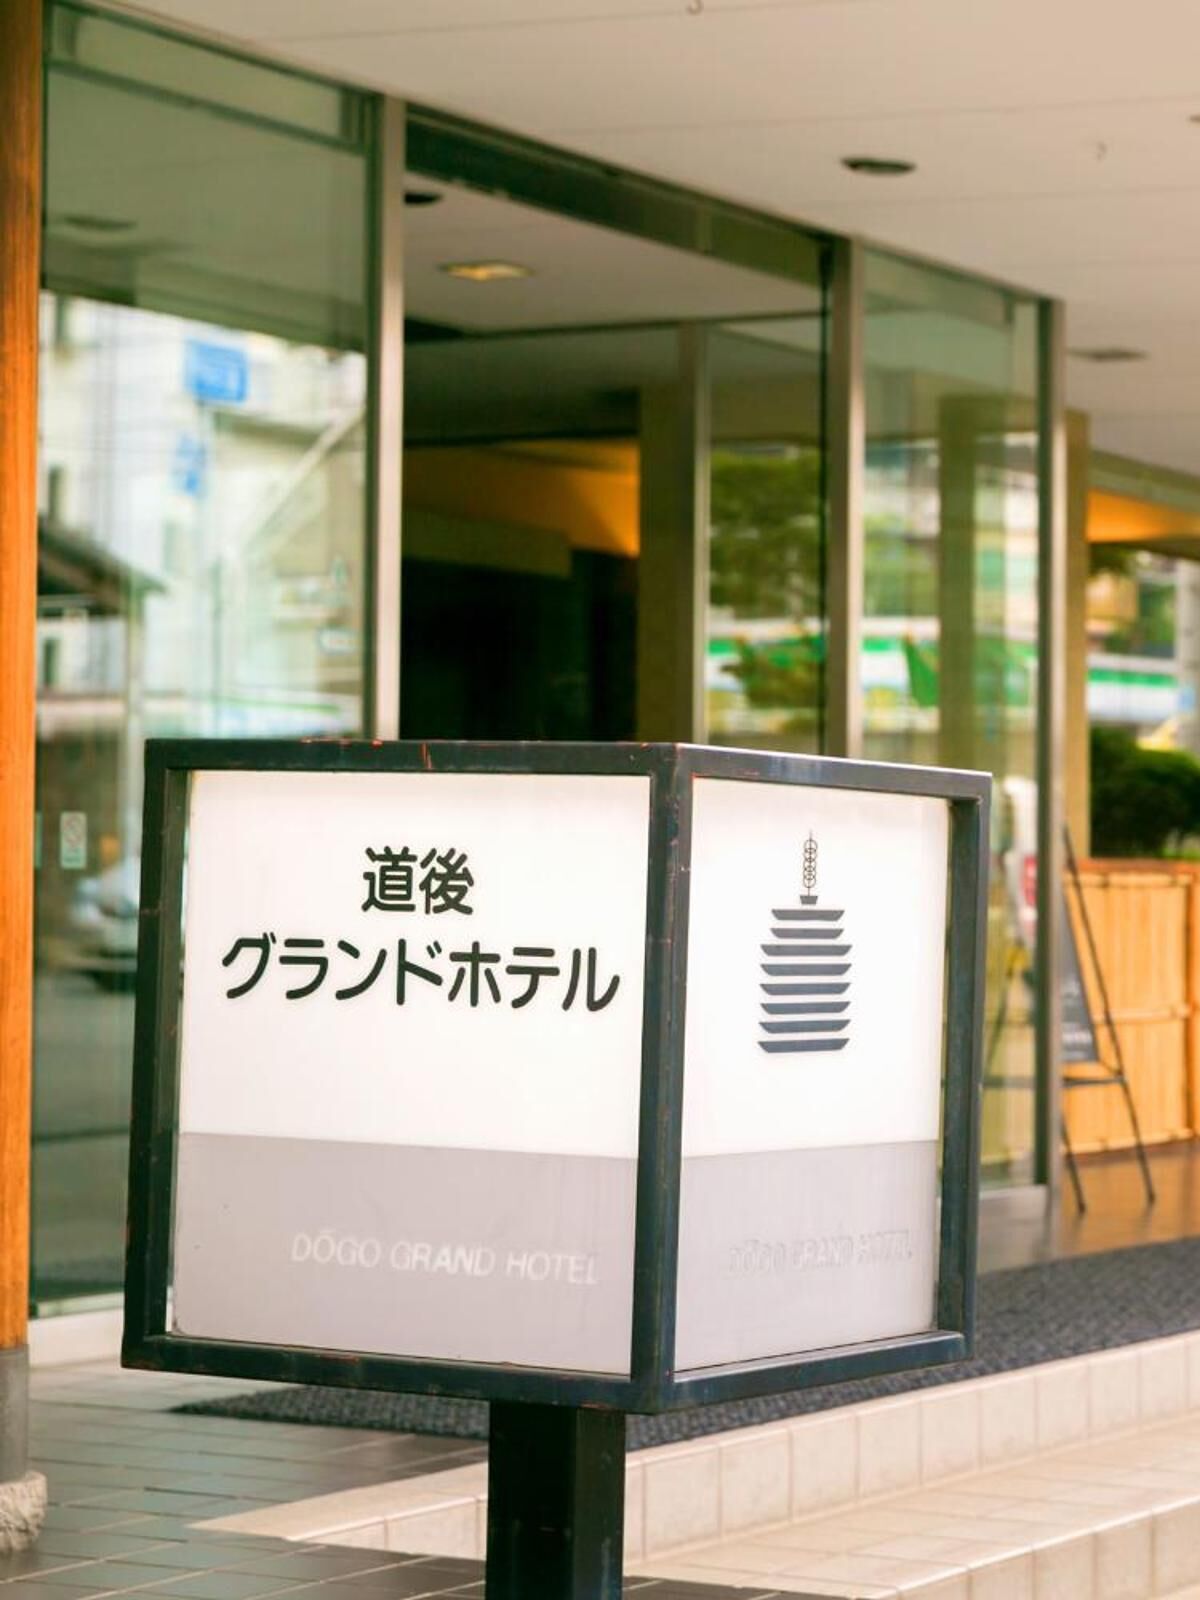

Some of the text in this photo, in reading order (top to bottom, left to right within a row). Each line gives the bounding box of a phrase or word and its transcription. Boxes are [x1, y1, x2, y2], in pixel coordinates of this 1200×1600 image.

[361, 846, 474, 915] 道後
[222, 932, 620, 1012] グランドホテル
[391, 1240, 496, 1276] GRAND
[504, 1250, 599, 1284] HOTEL
